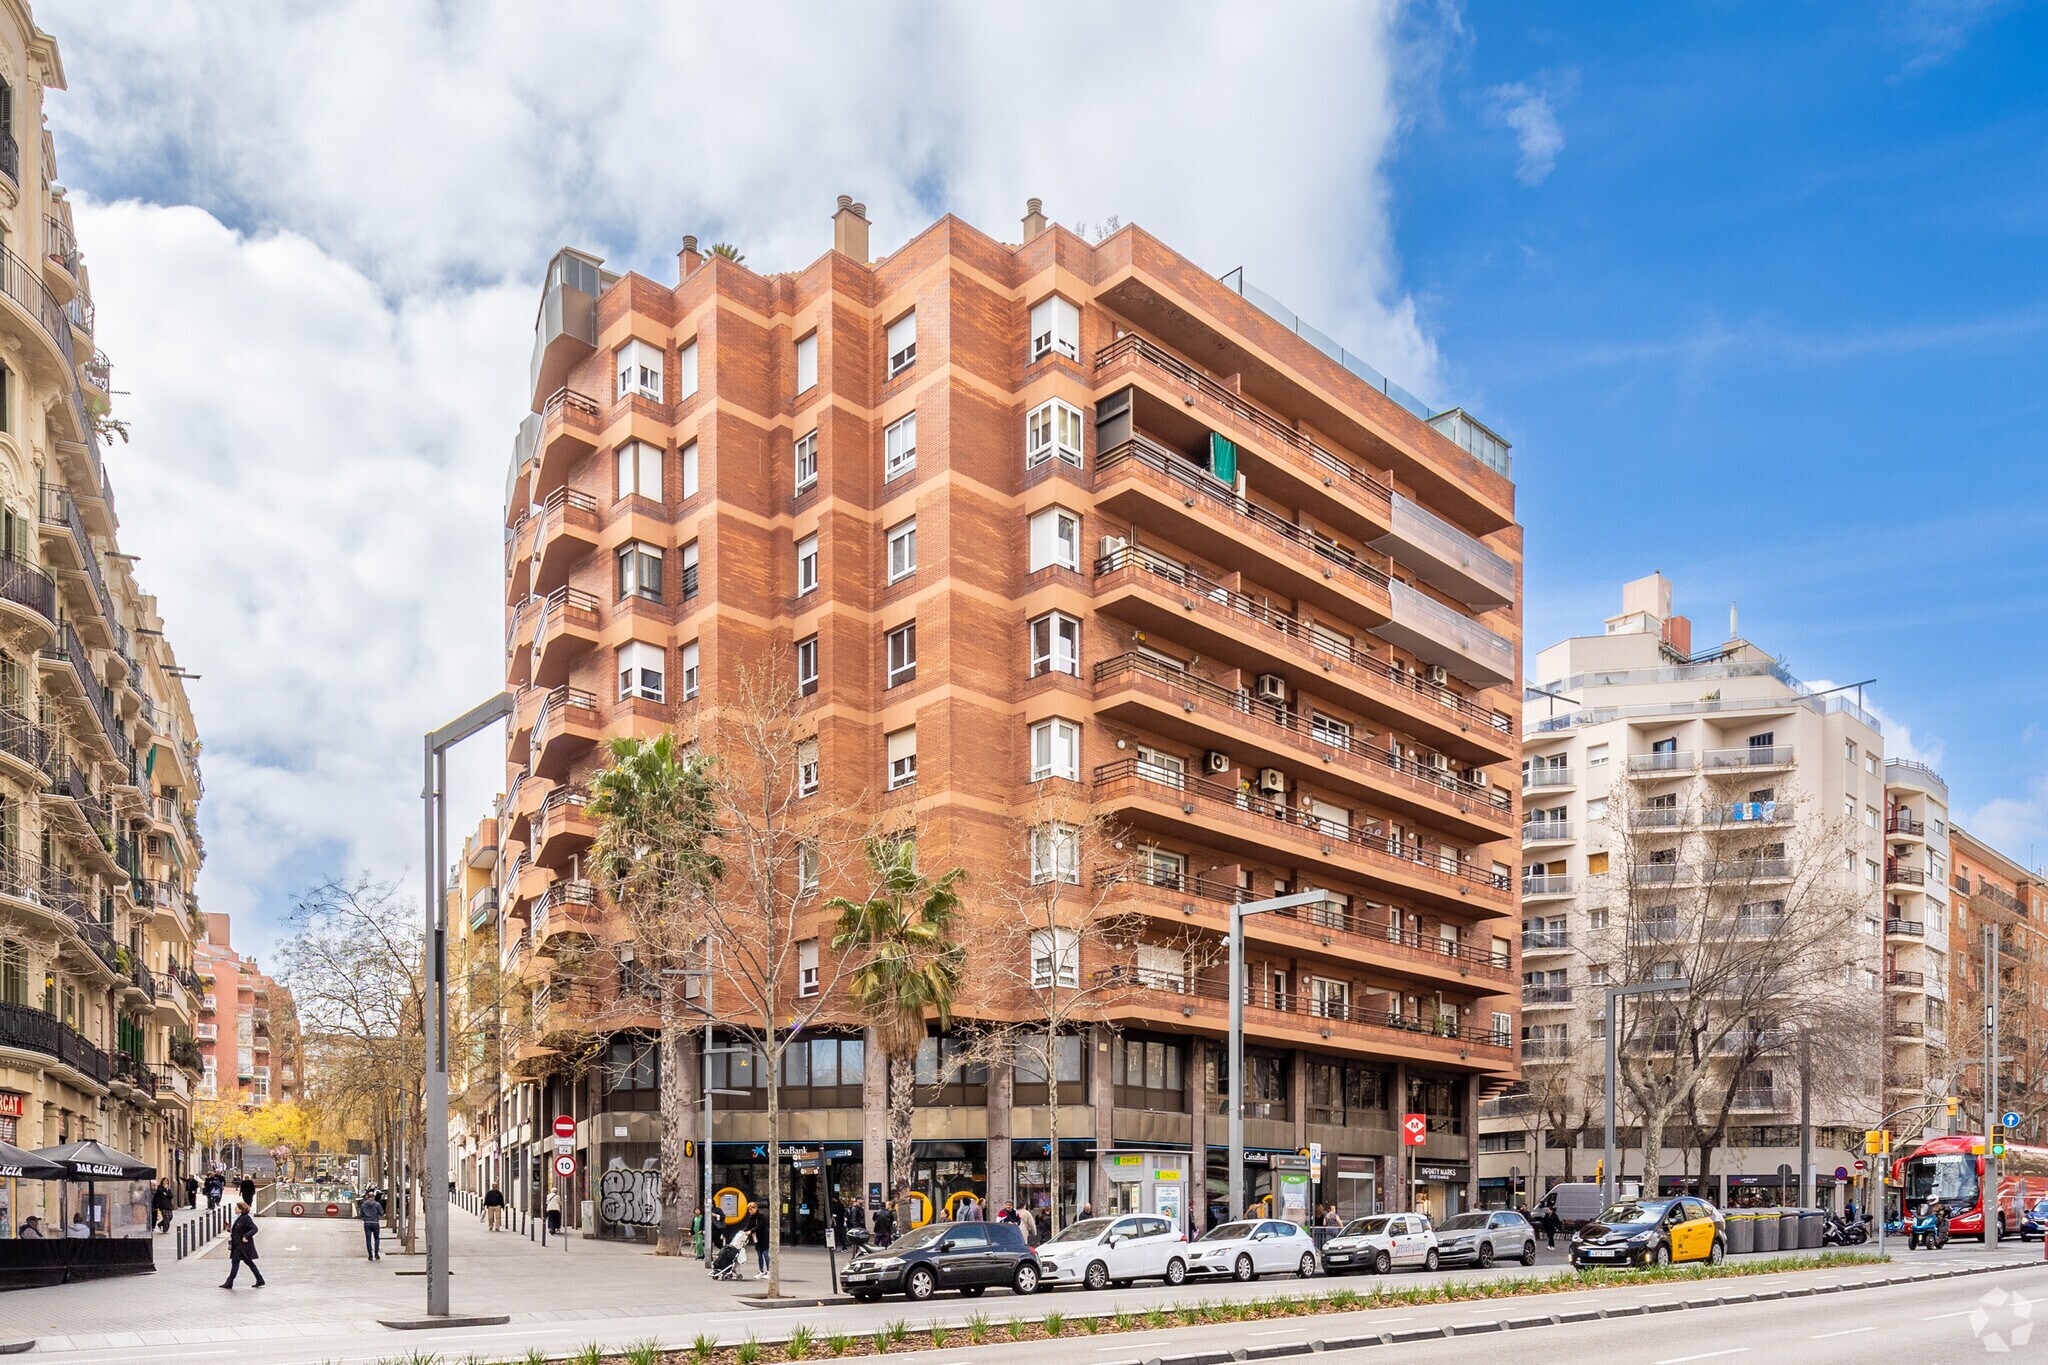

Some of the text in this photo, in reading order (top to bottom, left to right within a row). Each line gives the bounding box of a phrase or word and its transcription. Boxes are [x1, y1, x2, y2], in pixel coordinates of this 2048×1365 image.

[768, 1146, 808, 1155] ixaBank
[1121, 1156, 1140, 1164] ONCE
[1243, 1152, 1268, 1161] CaixaBank
[76, 1163, 123, 1176] BAR GALICIA
[560, 1162, 570, 1170] 10
[1440, 1168, 1457, 1176] MARKS
